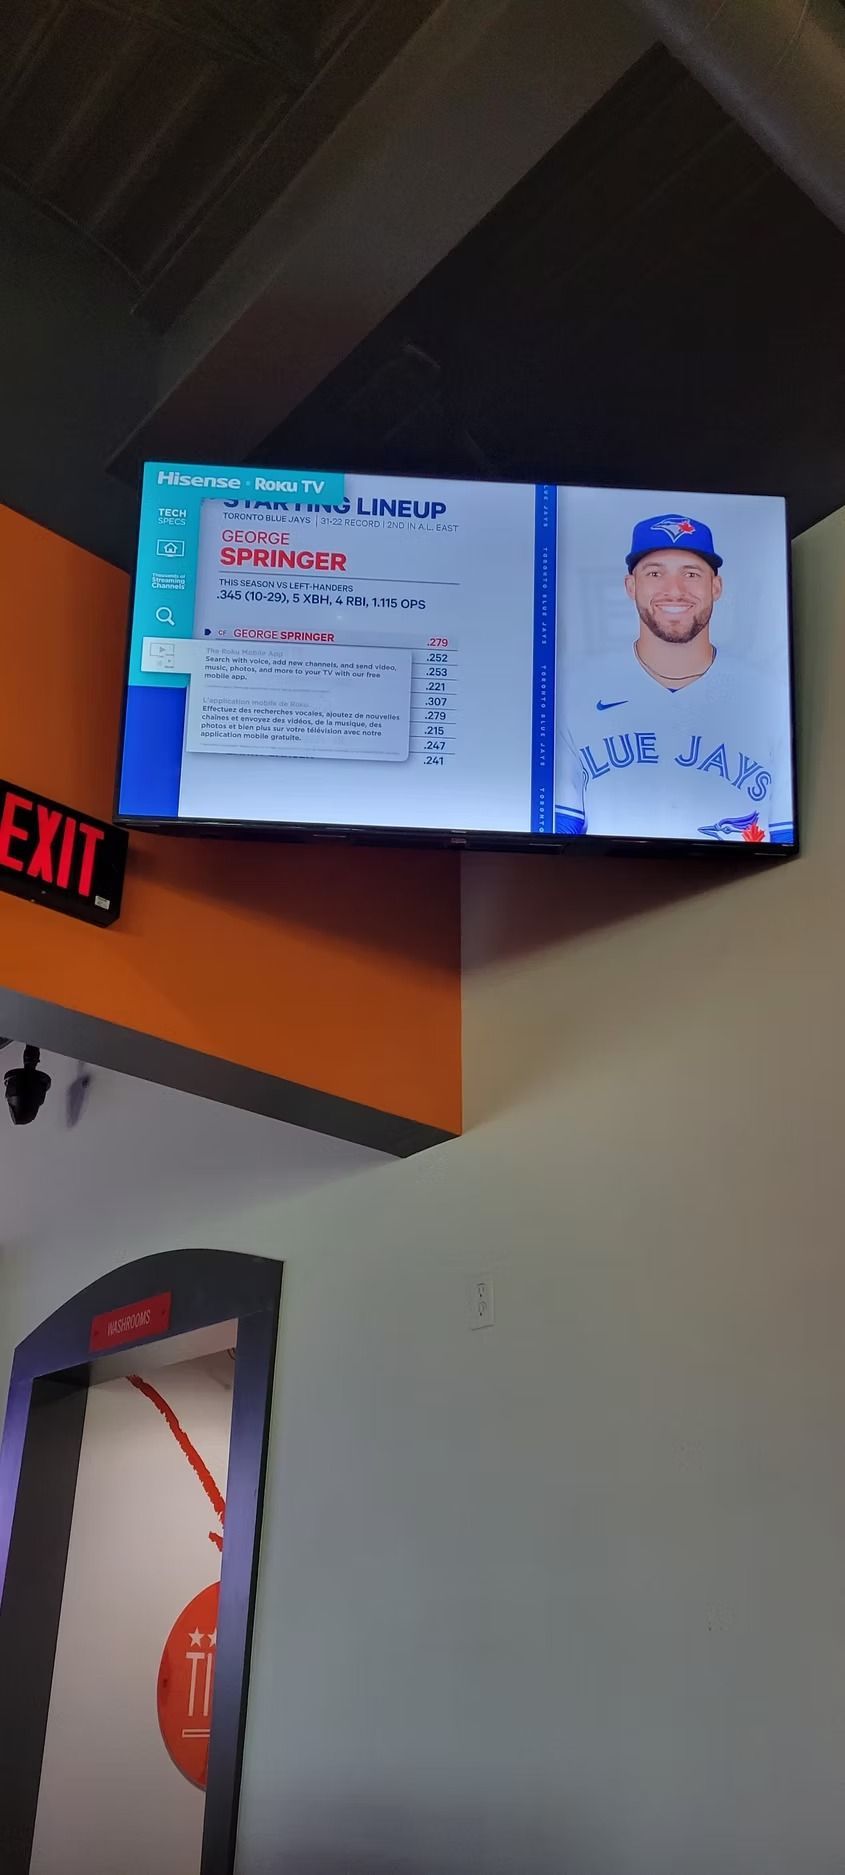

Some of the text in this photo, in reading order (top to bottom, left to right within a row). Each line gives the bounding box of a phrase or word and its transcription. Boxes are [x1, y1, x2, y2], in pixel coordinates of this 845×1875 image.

[158, 471, 325, 494] Hisense Roku TV
[159, 508, 187, 518] TECH
[357, 498, 447, 519] LINEUP
[158, 518, 186, 526] SPECS
[223, 512, 264, 522] TORONTO
[266, 514, 287, 522] BLUE
[288, 516, 311, 524] JAYS
[344, 519, 380, 528] RECORD
[387, 521, 404, 530] 2ND
[408, 522, 416, 530] IN
[418, 523, 434, 531] A.L.
[436, 524, 459, 532] EAST
[222, 530, 290, 546] GEORGE
[220, 547, 347, 572] SPRINGER
[219, 578, 238, 586] THIS
[240, 580, 274, 588] SEASON
[290, 582, 354, 592] LEFT-HANDERS
[216, 590, 426, 610] .345 (10-29), 5 XBH, 4 RBI, 1.115 OPS
[234, 628, 278, 639] GEORGE
[280, 632, 335, 642] SPRINGER
[427, 638, 448, 648] .279
[426, 653, 448, 662] .252
[230, 665, 257, 673] photos,
[426, 668, 448, 676] .253
[426, 682, 446, 691] .221
[425, 697, 448, 706] .307
[424, 711, 446, 720] .279
[335, 720, 368, 728] musique,
[306, 726, 342, 734] télévision
[424, 726, 444, 736] .215
[424, 741, 446, 750] .247
[424, 756, 444, 766] .241
[580, 732, 772, 801] LUE JAYS
[0, 792, 105, 897] EXIT
[106, 1309, 151, 1336] WASHROOMS
